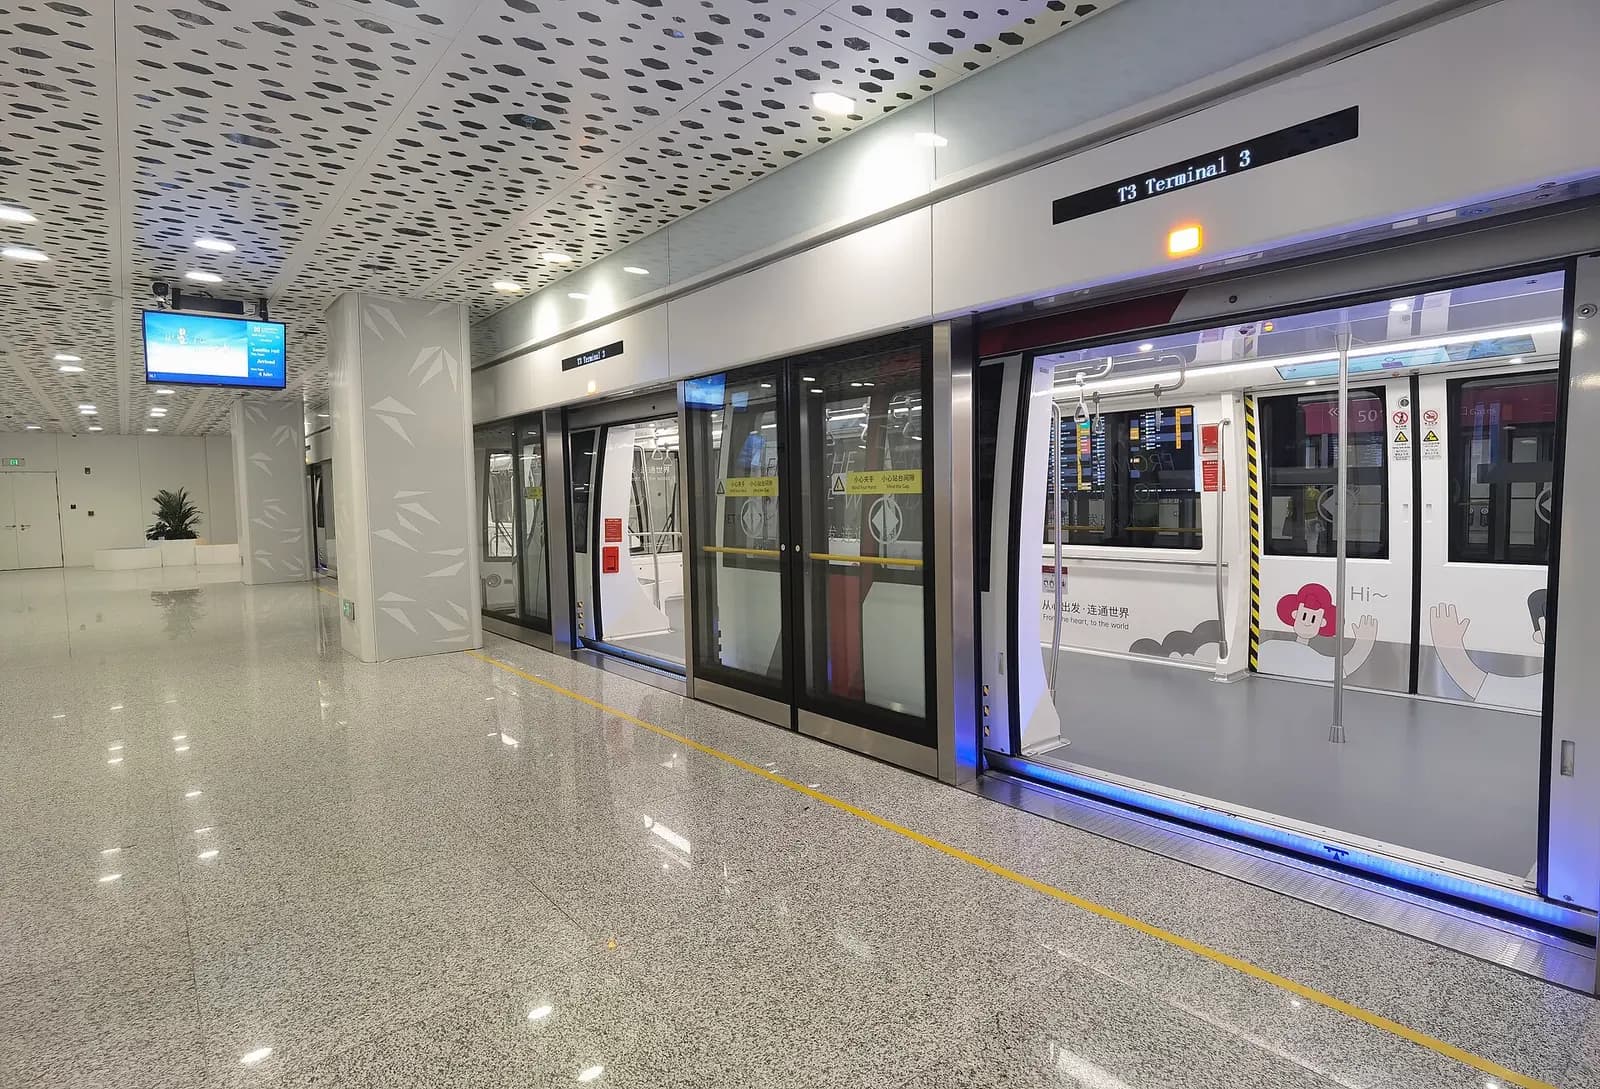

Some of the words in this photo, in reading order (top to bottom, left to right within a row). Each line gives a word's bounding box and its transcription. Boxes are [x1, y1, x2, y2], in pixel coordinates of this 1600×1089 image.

[1117, 183, 1137, 203] T3
[1145, 156, 1226, 195] Terminal
[1239, 149, 1251, 168] 3
[1111, 622, 1130, 630] world
